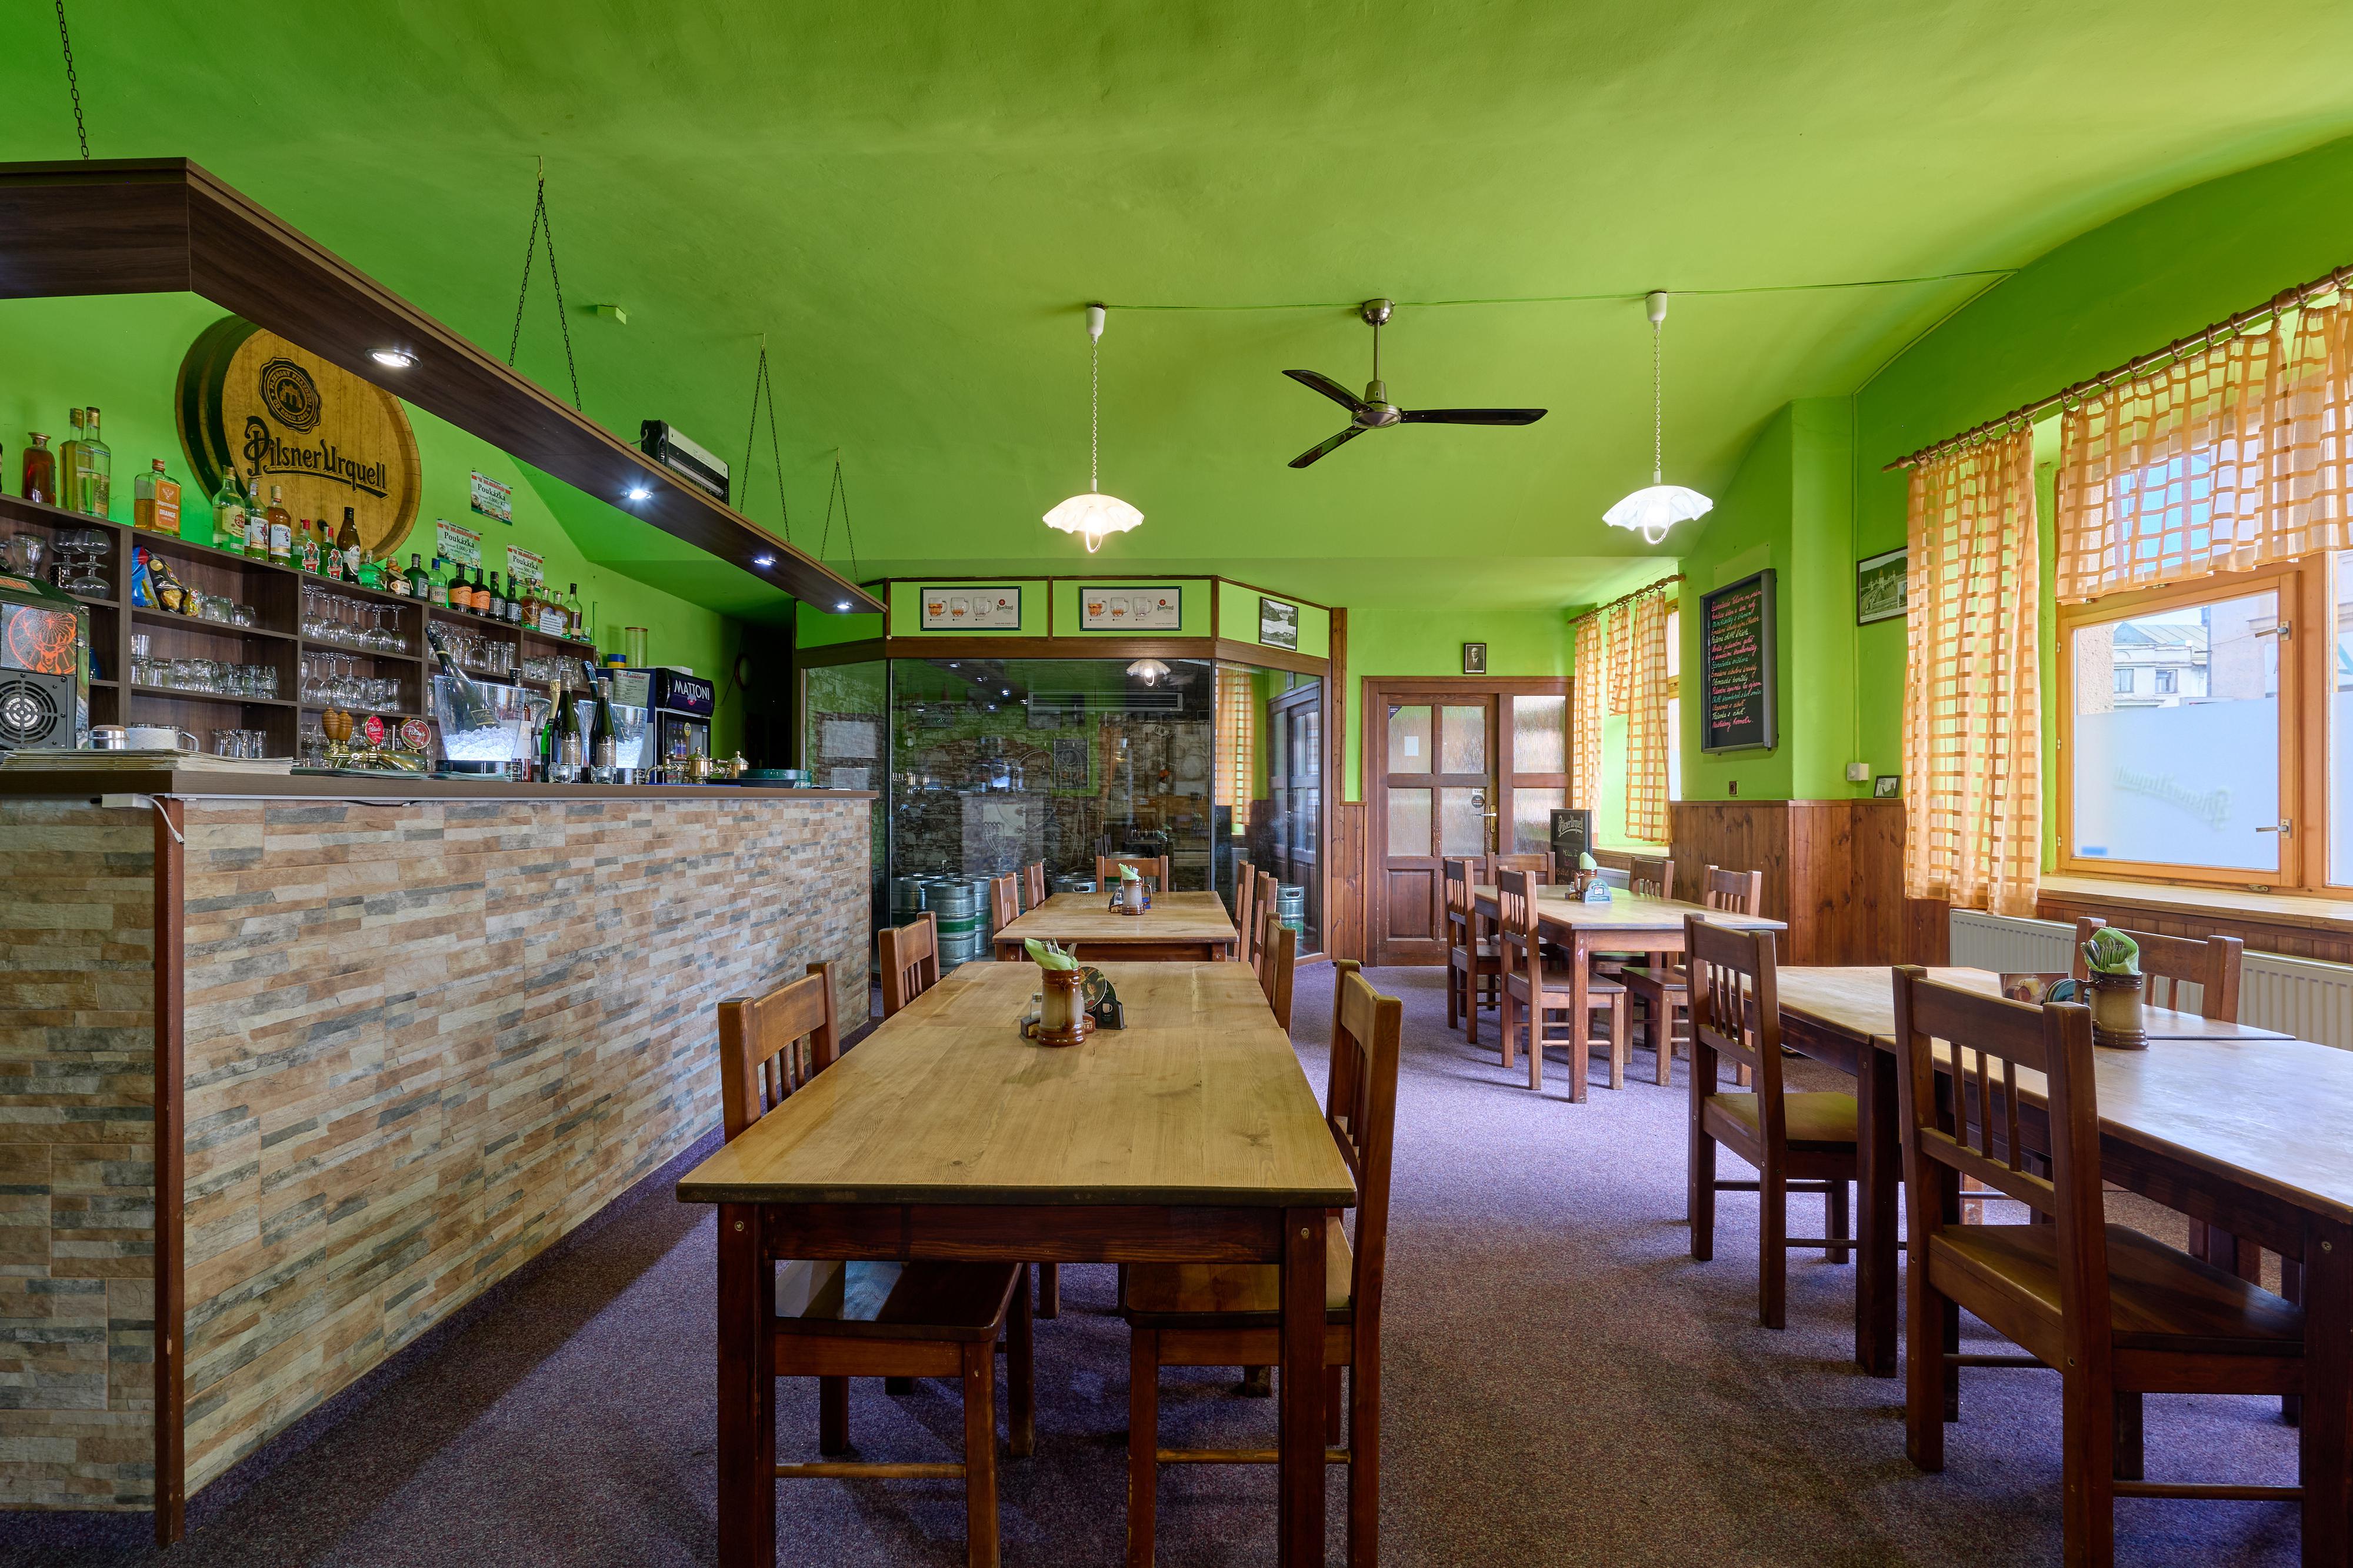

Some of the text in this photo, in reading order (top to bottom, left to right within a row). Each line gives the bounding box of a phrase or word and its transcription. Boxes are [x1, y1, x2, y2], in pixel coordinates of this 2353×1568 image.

[273, 400, 309, 421] OD ROKU 1842
[244, 416, 386, 491] Pilsner Urquell
[478, 483, 505, 501] Poukázka
[444, 532, 474, 548] Poukázka
[513, 556, 538, 570] Poukázka
[674, 680, 709, 700] MATTONI
[1558, 815, 1583, 838] Pilsner Urquell
[1578, 948, 1583, 962] 1
